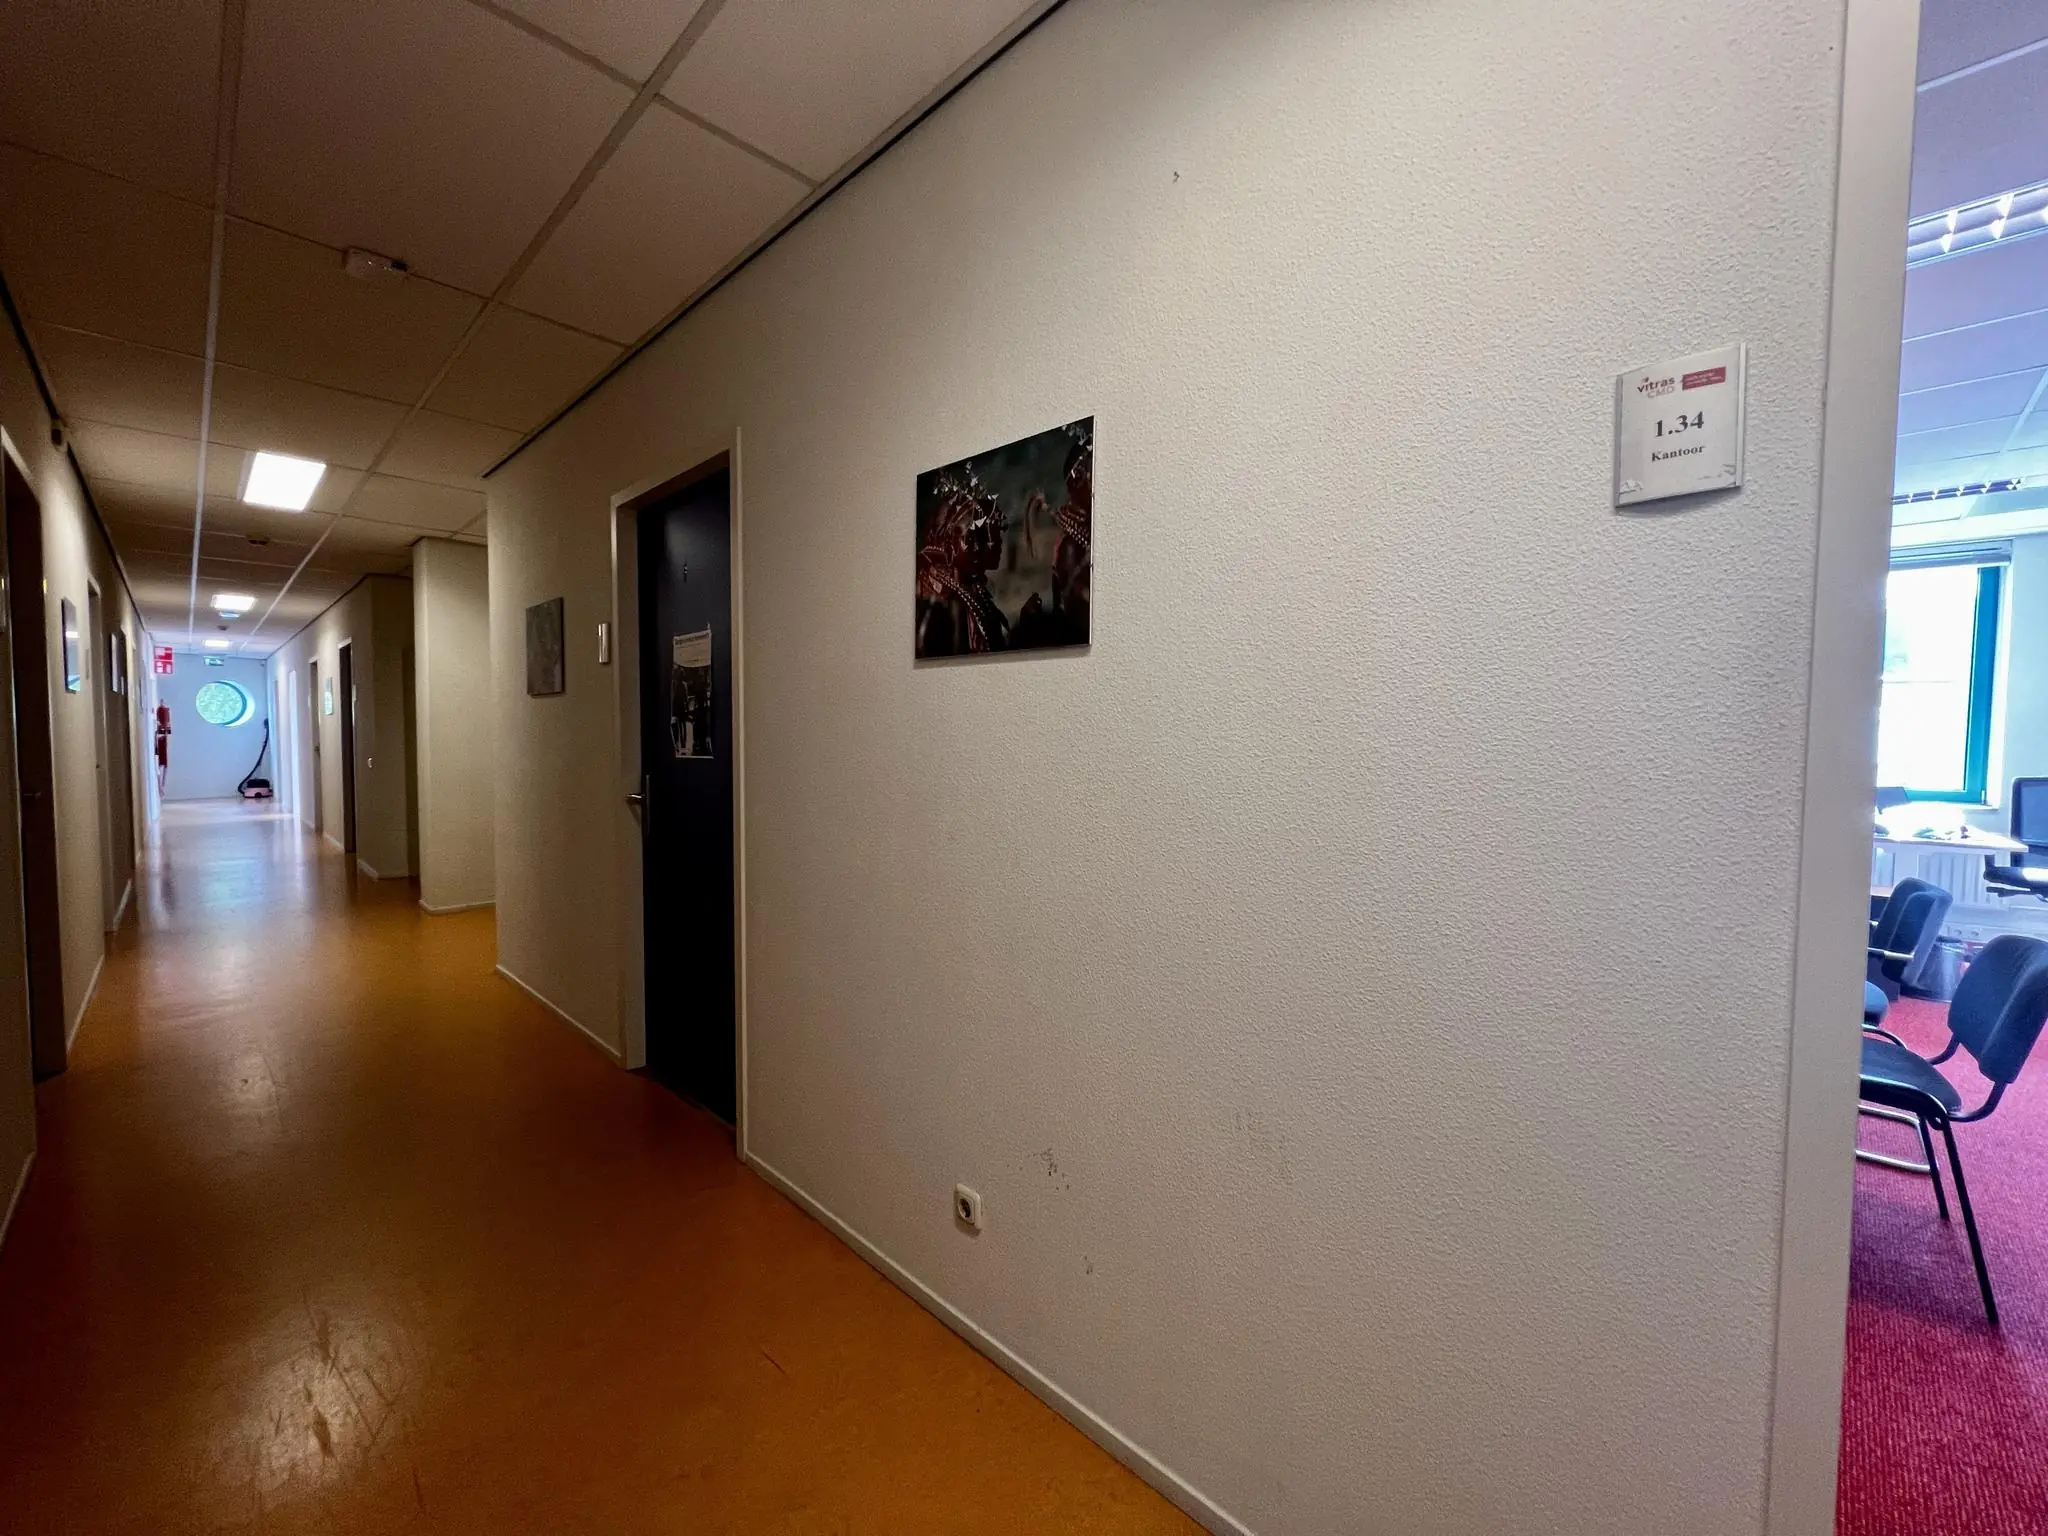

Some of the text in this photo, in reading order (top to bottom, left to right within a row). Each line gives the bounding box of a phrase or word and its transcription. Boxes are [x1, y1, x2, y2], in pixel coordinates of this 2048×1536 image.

[1637, 376, 1675, 393] vitras
[1654, 411, 1705, 438] 1.34
[1651, 445, 1706, 462] Kantoor
